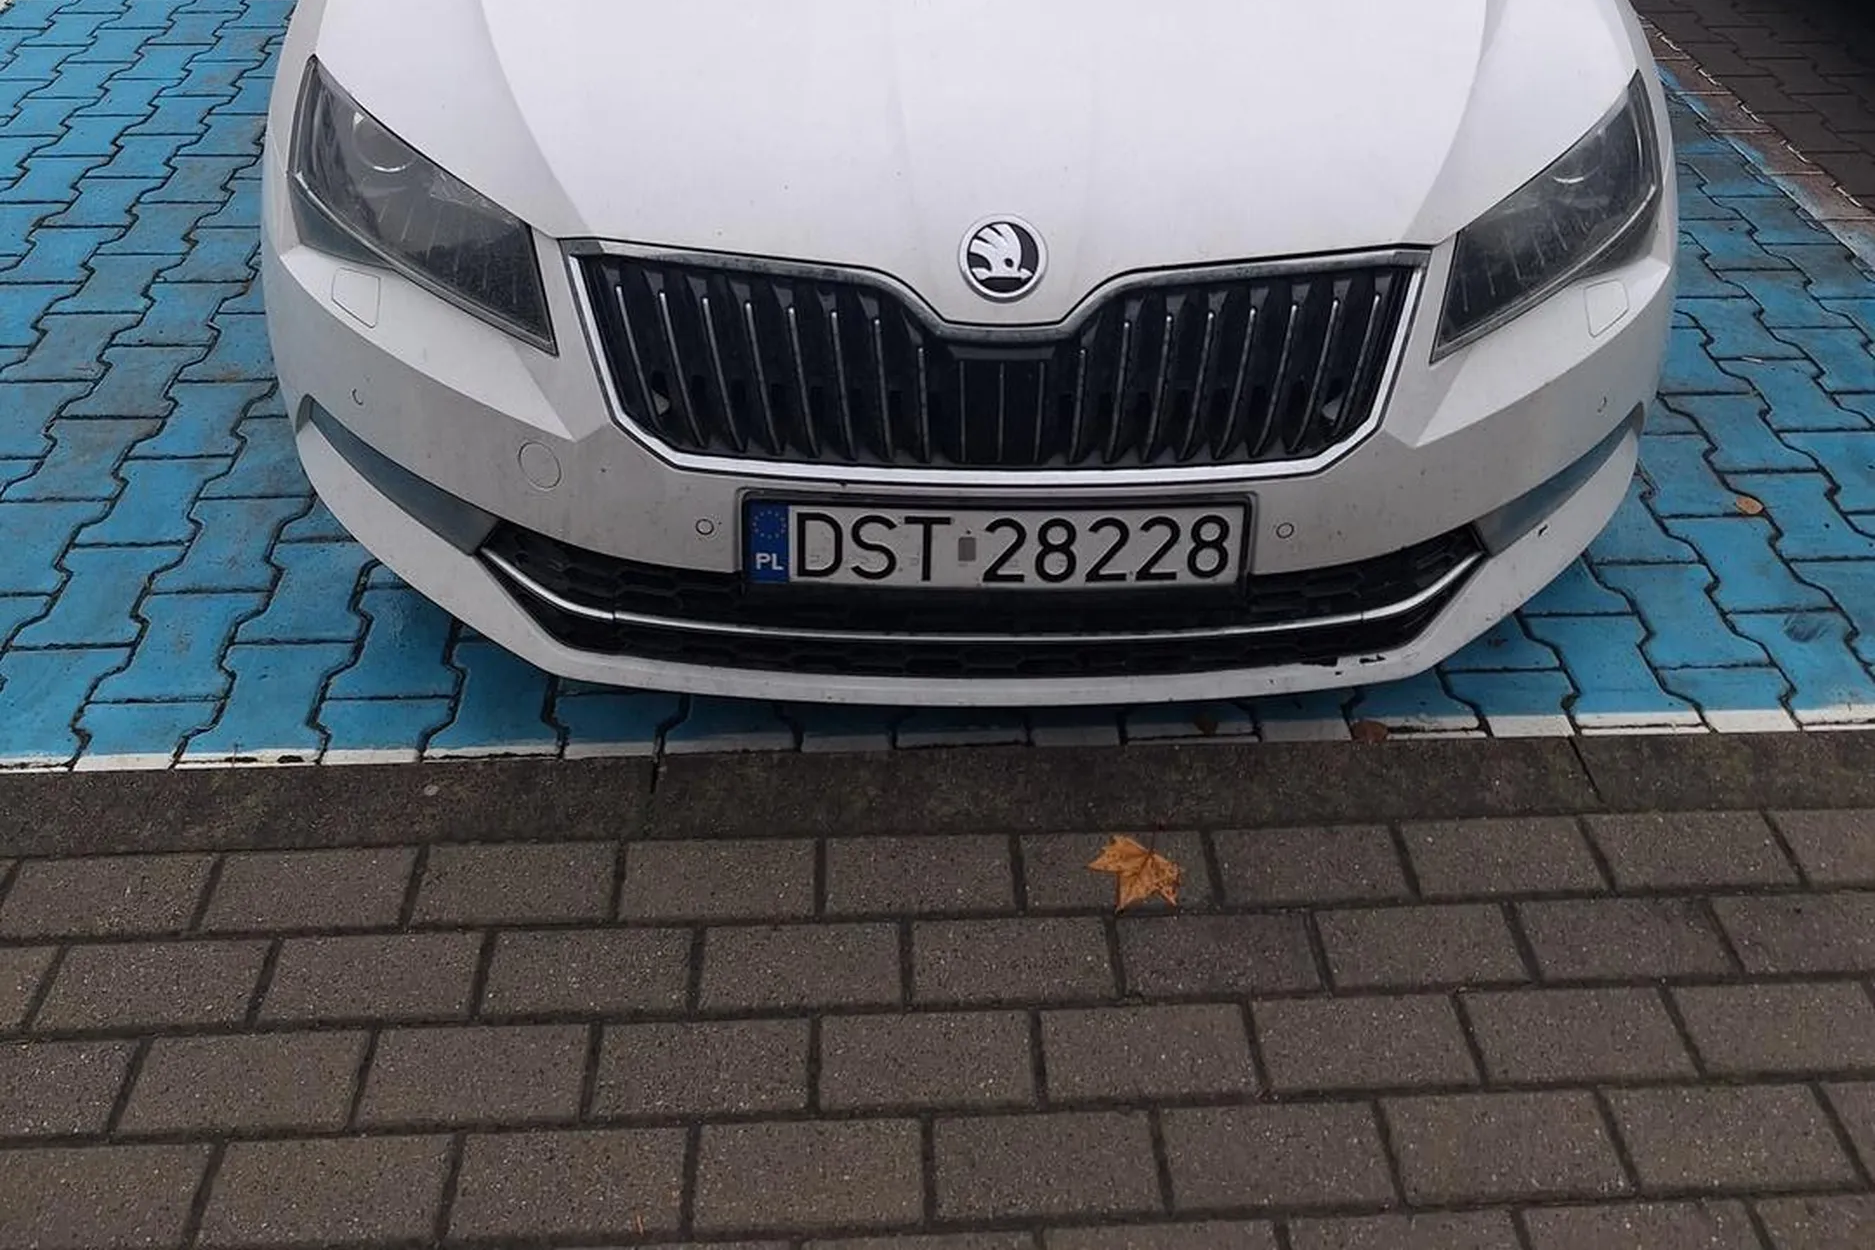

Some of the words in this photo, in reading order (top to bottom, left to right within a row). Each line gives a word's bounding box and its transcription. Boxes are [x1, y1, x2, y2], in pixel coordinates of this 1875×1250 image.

[755, 553, 784, 570] PL
[797, 512, 951, 581] DST
[982, 514, 1230, 583] 28228
